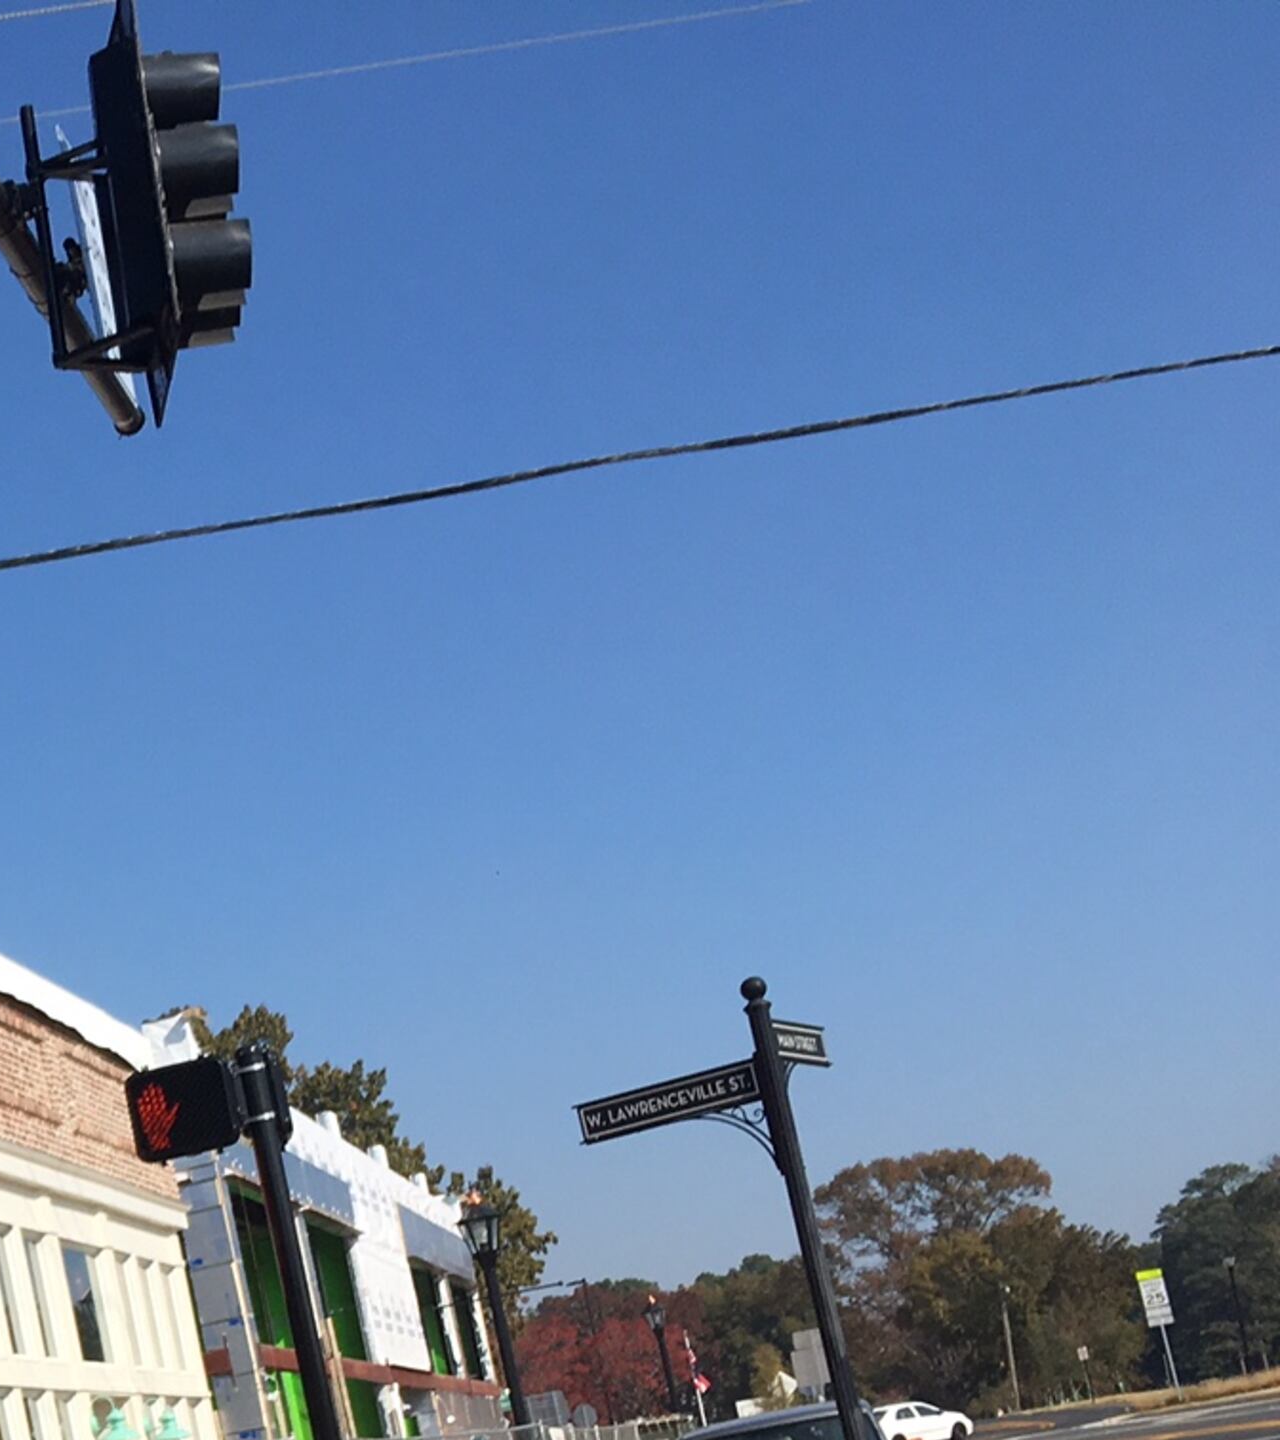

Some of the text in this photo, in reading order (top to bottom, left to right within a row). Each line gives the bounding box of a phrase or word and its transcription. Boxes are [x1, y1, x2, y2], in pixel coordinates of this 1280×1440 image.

[586, 1074, 752, 1128] W. LAWRENCEVILLE ST.
[1146, 1292, 1166, 1306] 25
